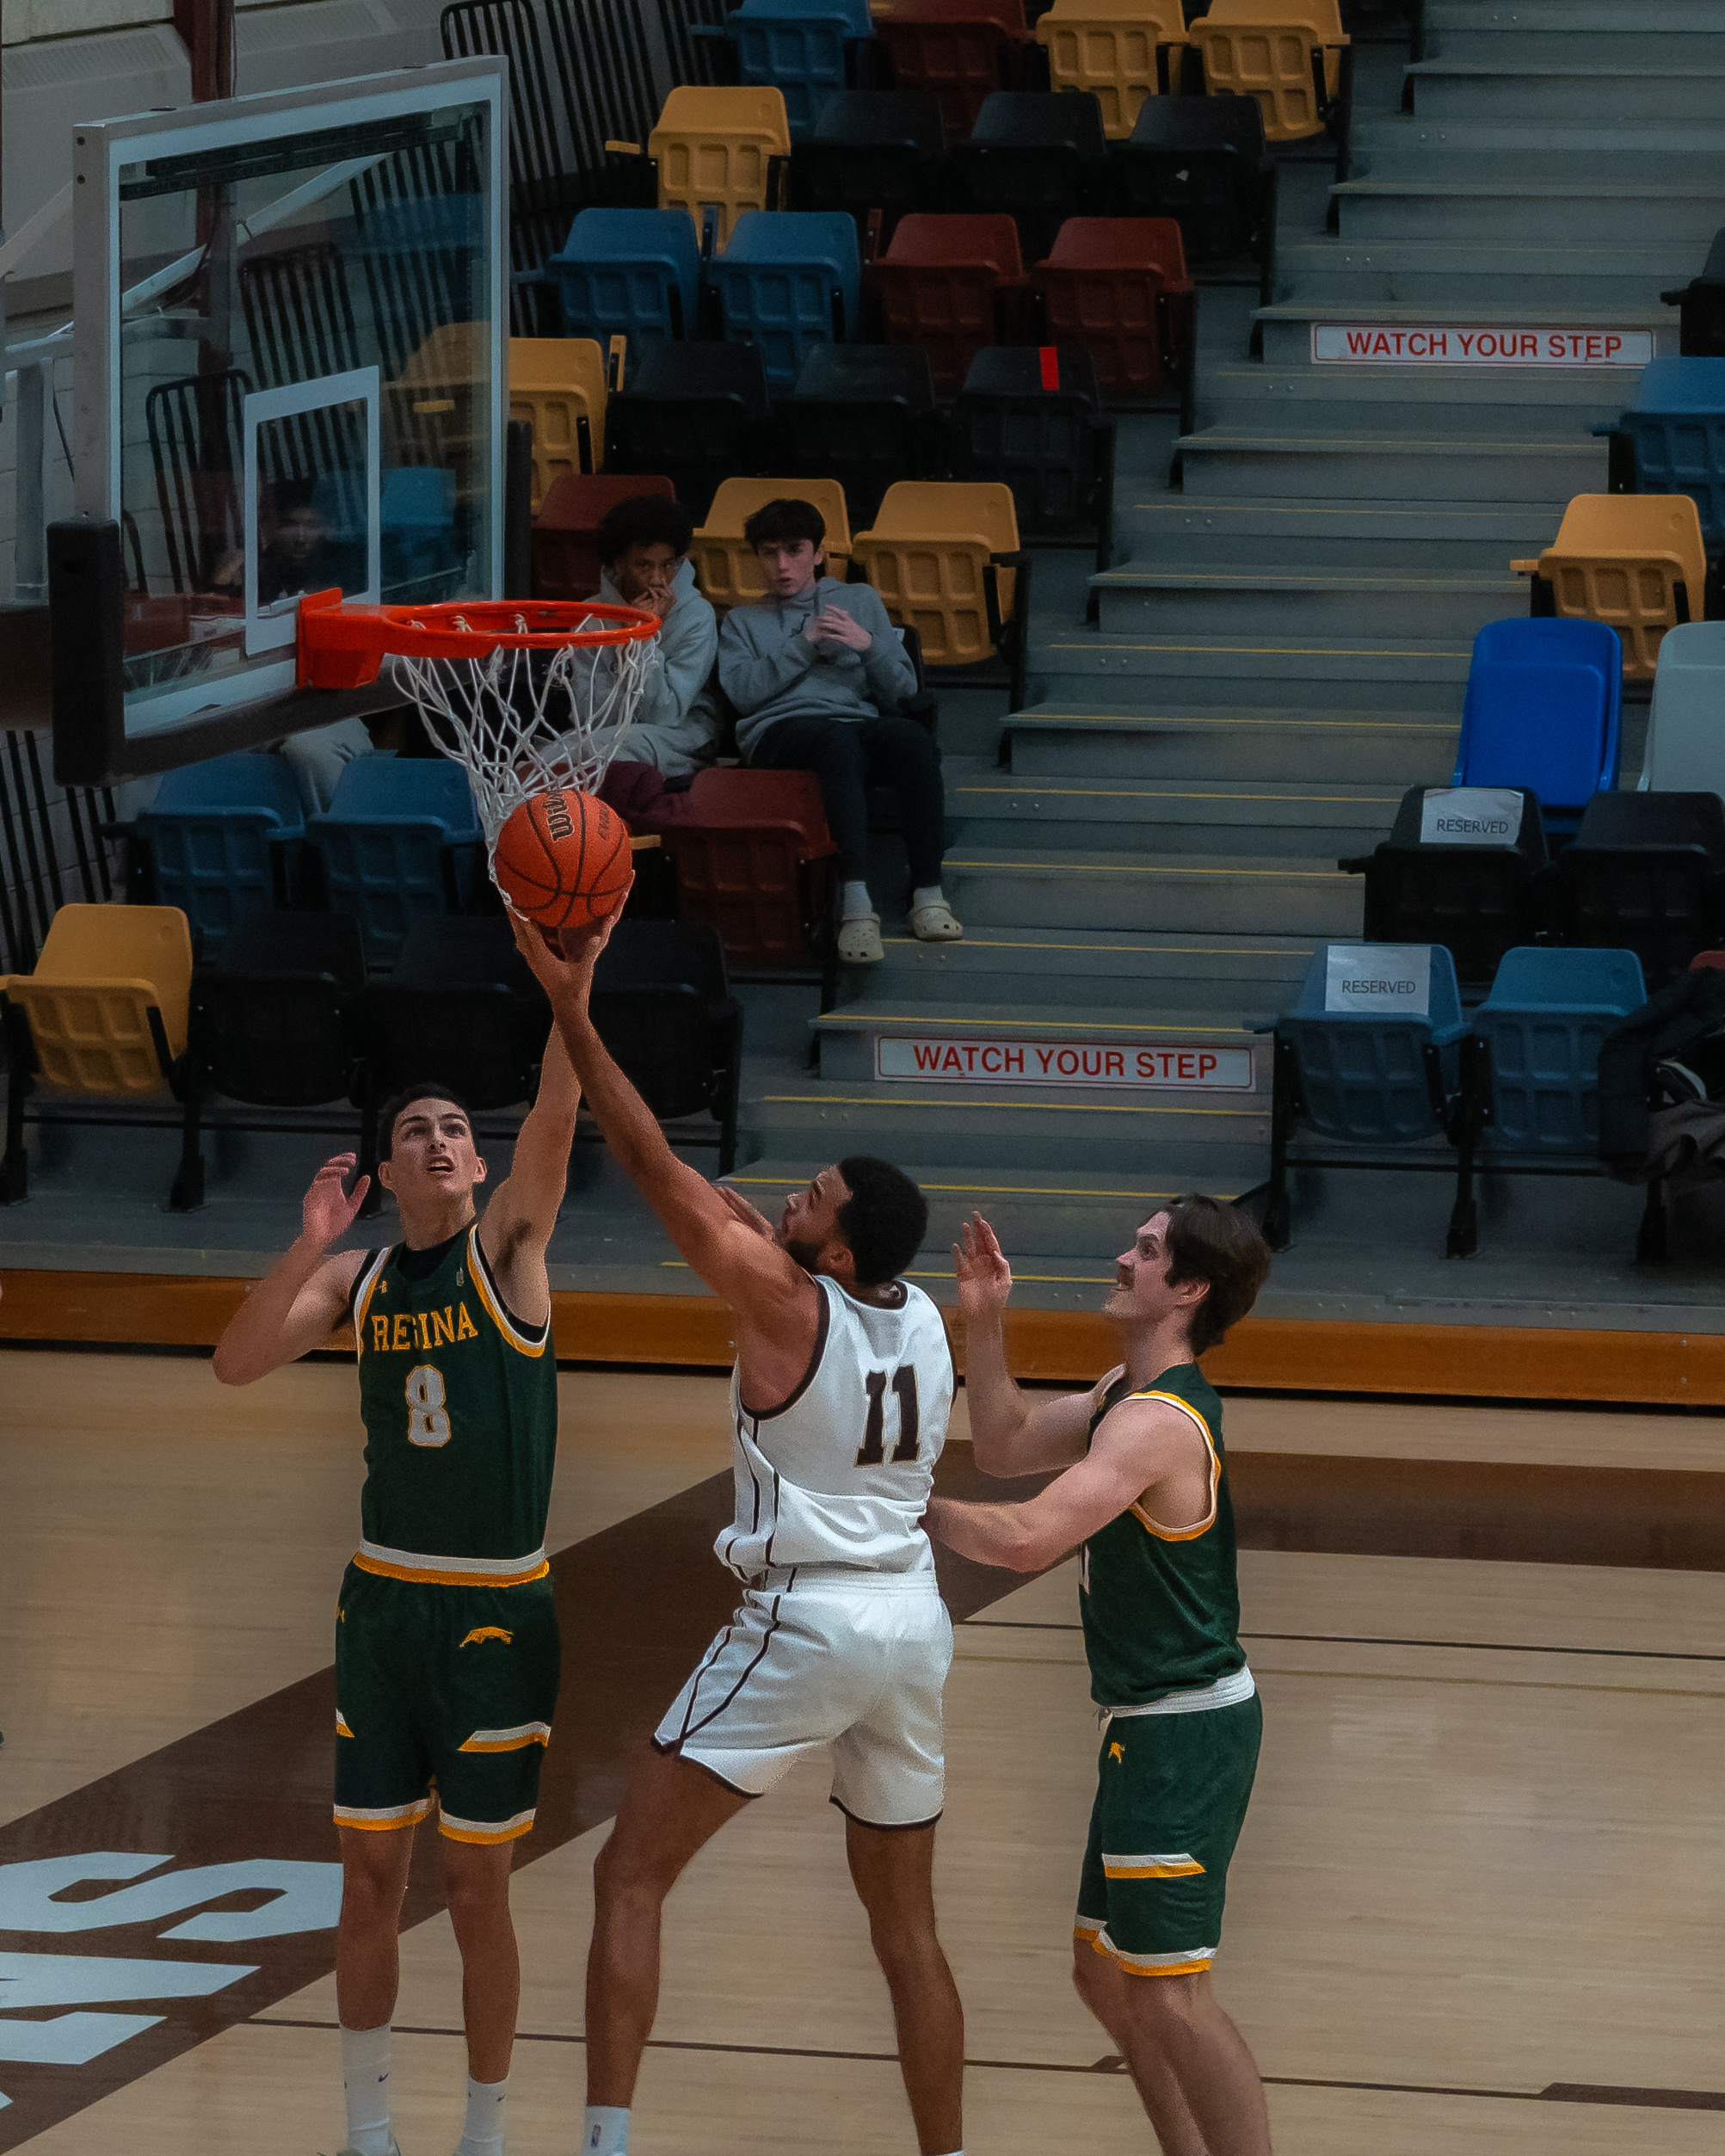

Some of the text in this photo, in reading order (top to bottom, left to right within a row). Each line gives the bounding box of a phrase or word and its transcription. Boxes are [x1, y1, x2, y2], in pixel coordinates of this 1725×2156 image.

[1346, 331, 1622, 360] WATCH YOUR STEP
[1436, 818, 1509, 834] RESERVED
[1342, 980, 1416, 994] RESERVED
[913, 1044, 1217, 1080] WATCH YOUR STEP
[404, 1364, 452, 1448] 8
[853, 1363, 921, 1468] 11
